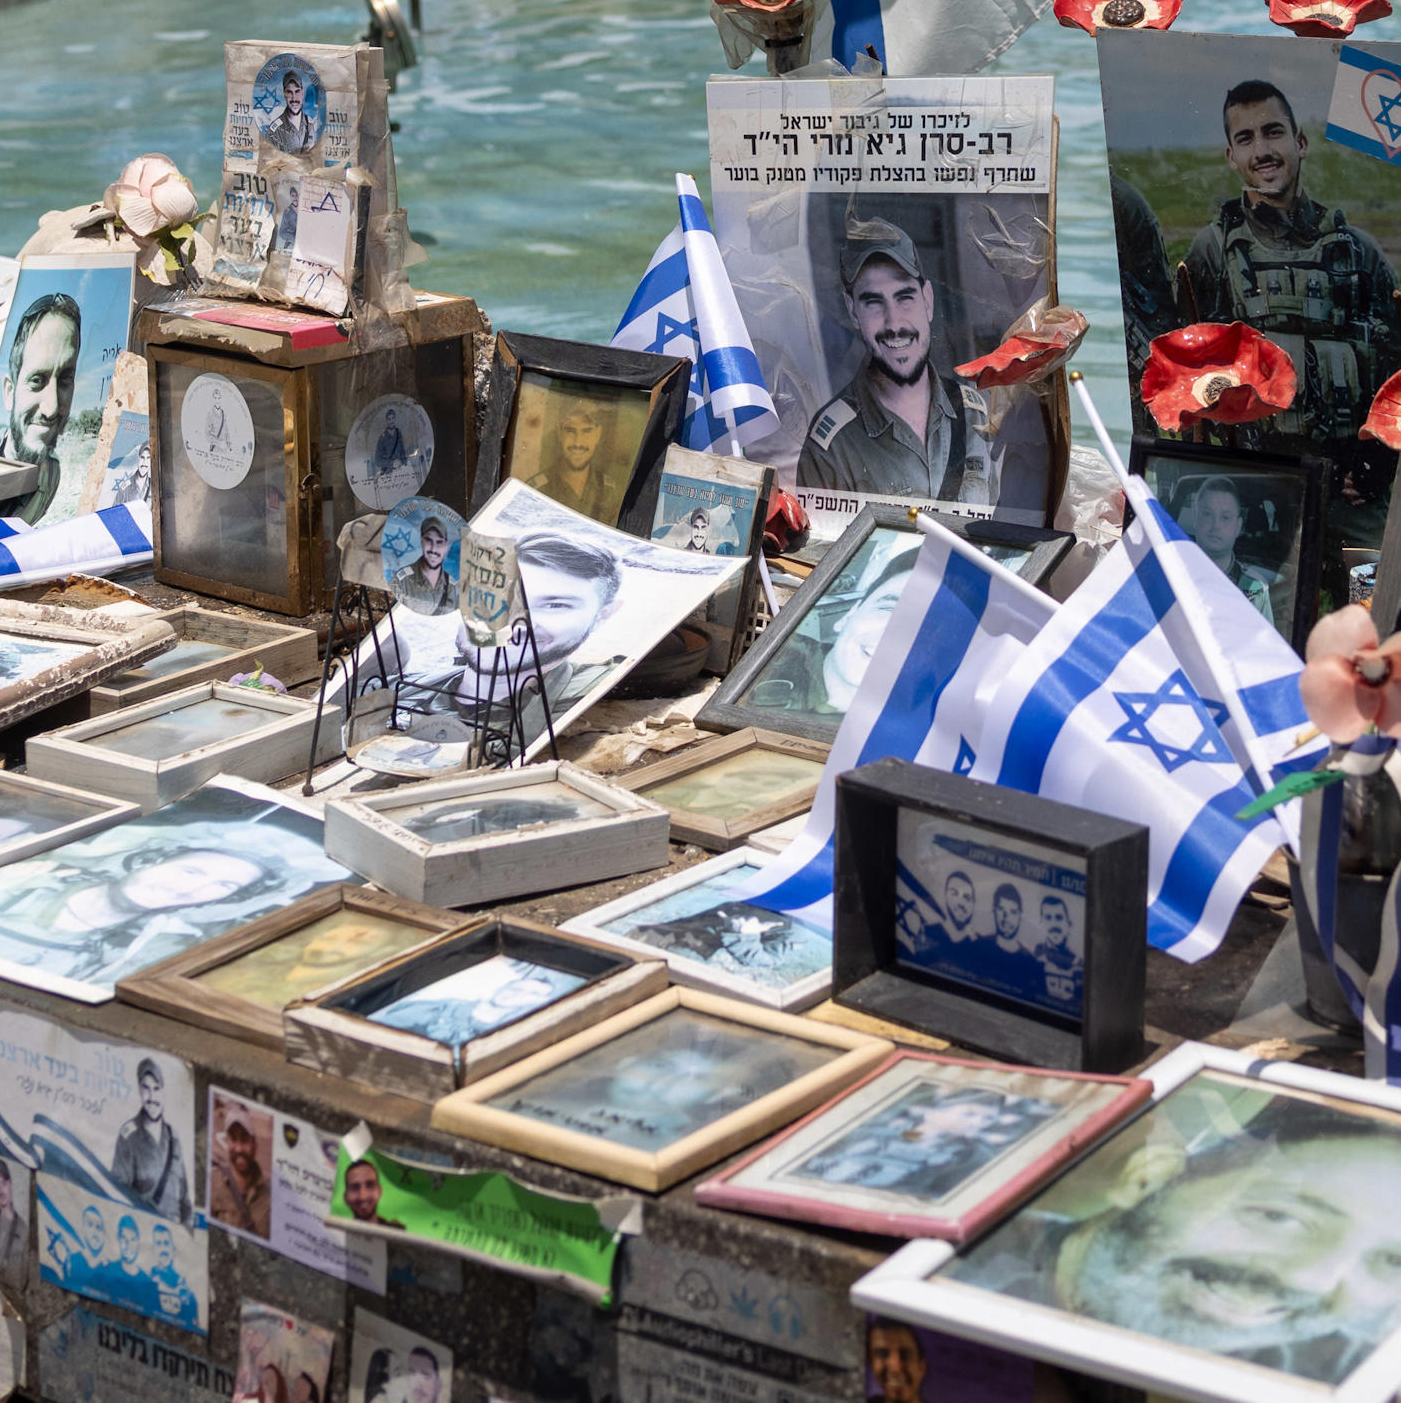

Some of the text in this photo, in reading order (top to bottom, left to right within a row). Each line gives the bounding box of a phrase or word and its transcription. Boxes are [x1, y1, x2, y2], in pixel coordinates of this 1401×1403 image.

[233, 99, 250, 113] טוב
[329, 109, 348, 124] טוב
[233, 126, 250, 137] בעד
[780, 111, 971, 130] לזיכרו של גיבור ישראל
[812, 131, 853, 155] נזרי
[866, 131, 907, 156] גיא
[920, 131, 1013, 161] רב-סרן
[232, 172, 268, 195] טוב
[724, 165, 1036, 186] שחרף נפשו בהצלת פקודיו מטנק בוער
[223, 192, 275, 218] לחיות
[230, 215, 264, 238] בעד
[102, 343, 122, 362] אריה
[45, 1054, 80, 1085] בעד
